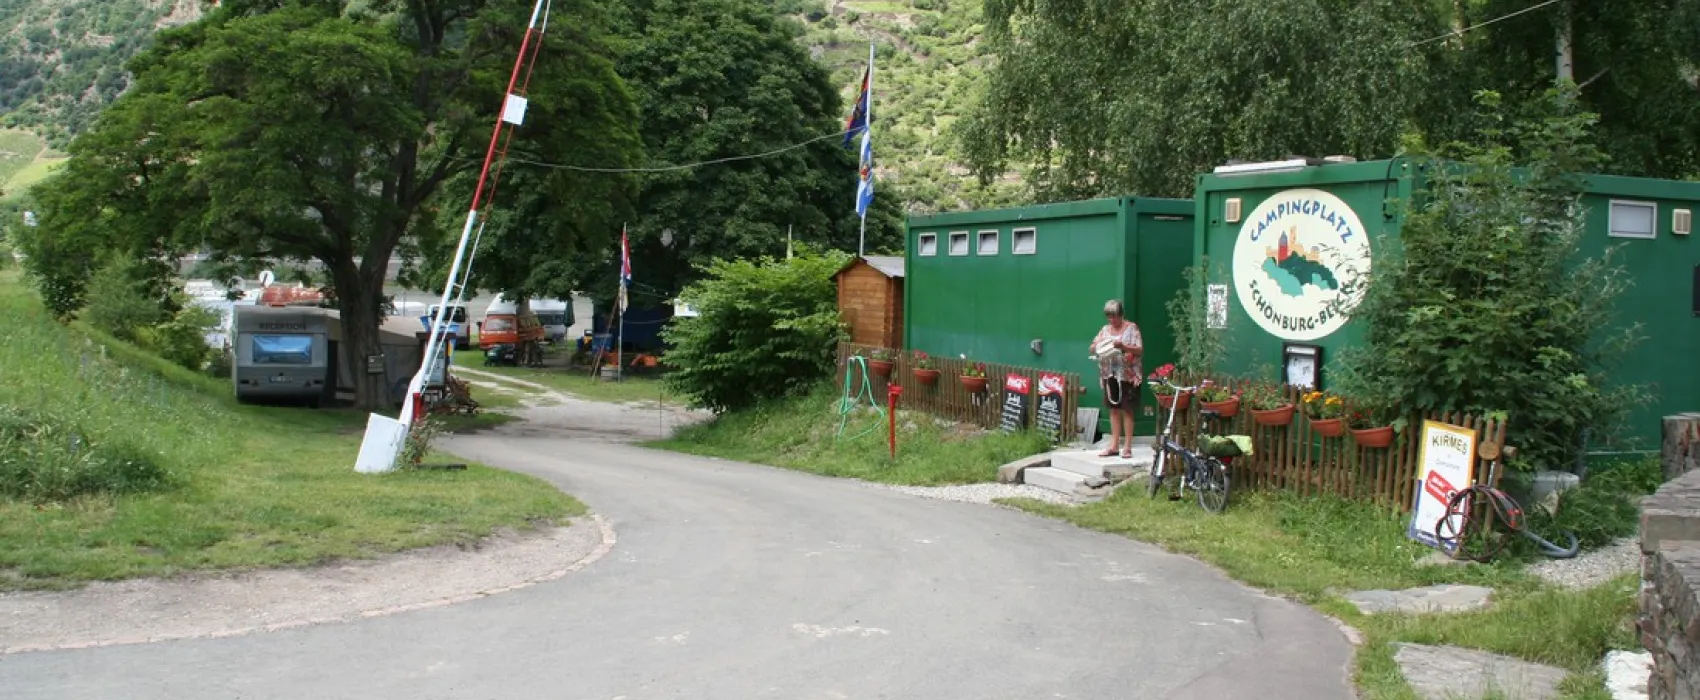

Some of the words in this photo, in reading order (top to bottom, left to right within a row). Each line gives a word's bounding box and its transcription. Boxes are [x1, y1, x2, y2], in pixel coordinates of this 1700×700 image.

[1250, 199, 1353, 243] CAMPINGPLATZ
[259, 321, 307, 330] RECEPTION
[1432, 435, 1467, 455] KIRMES
